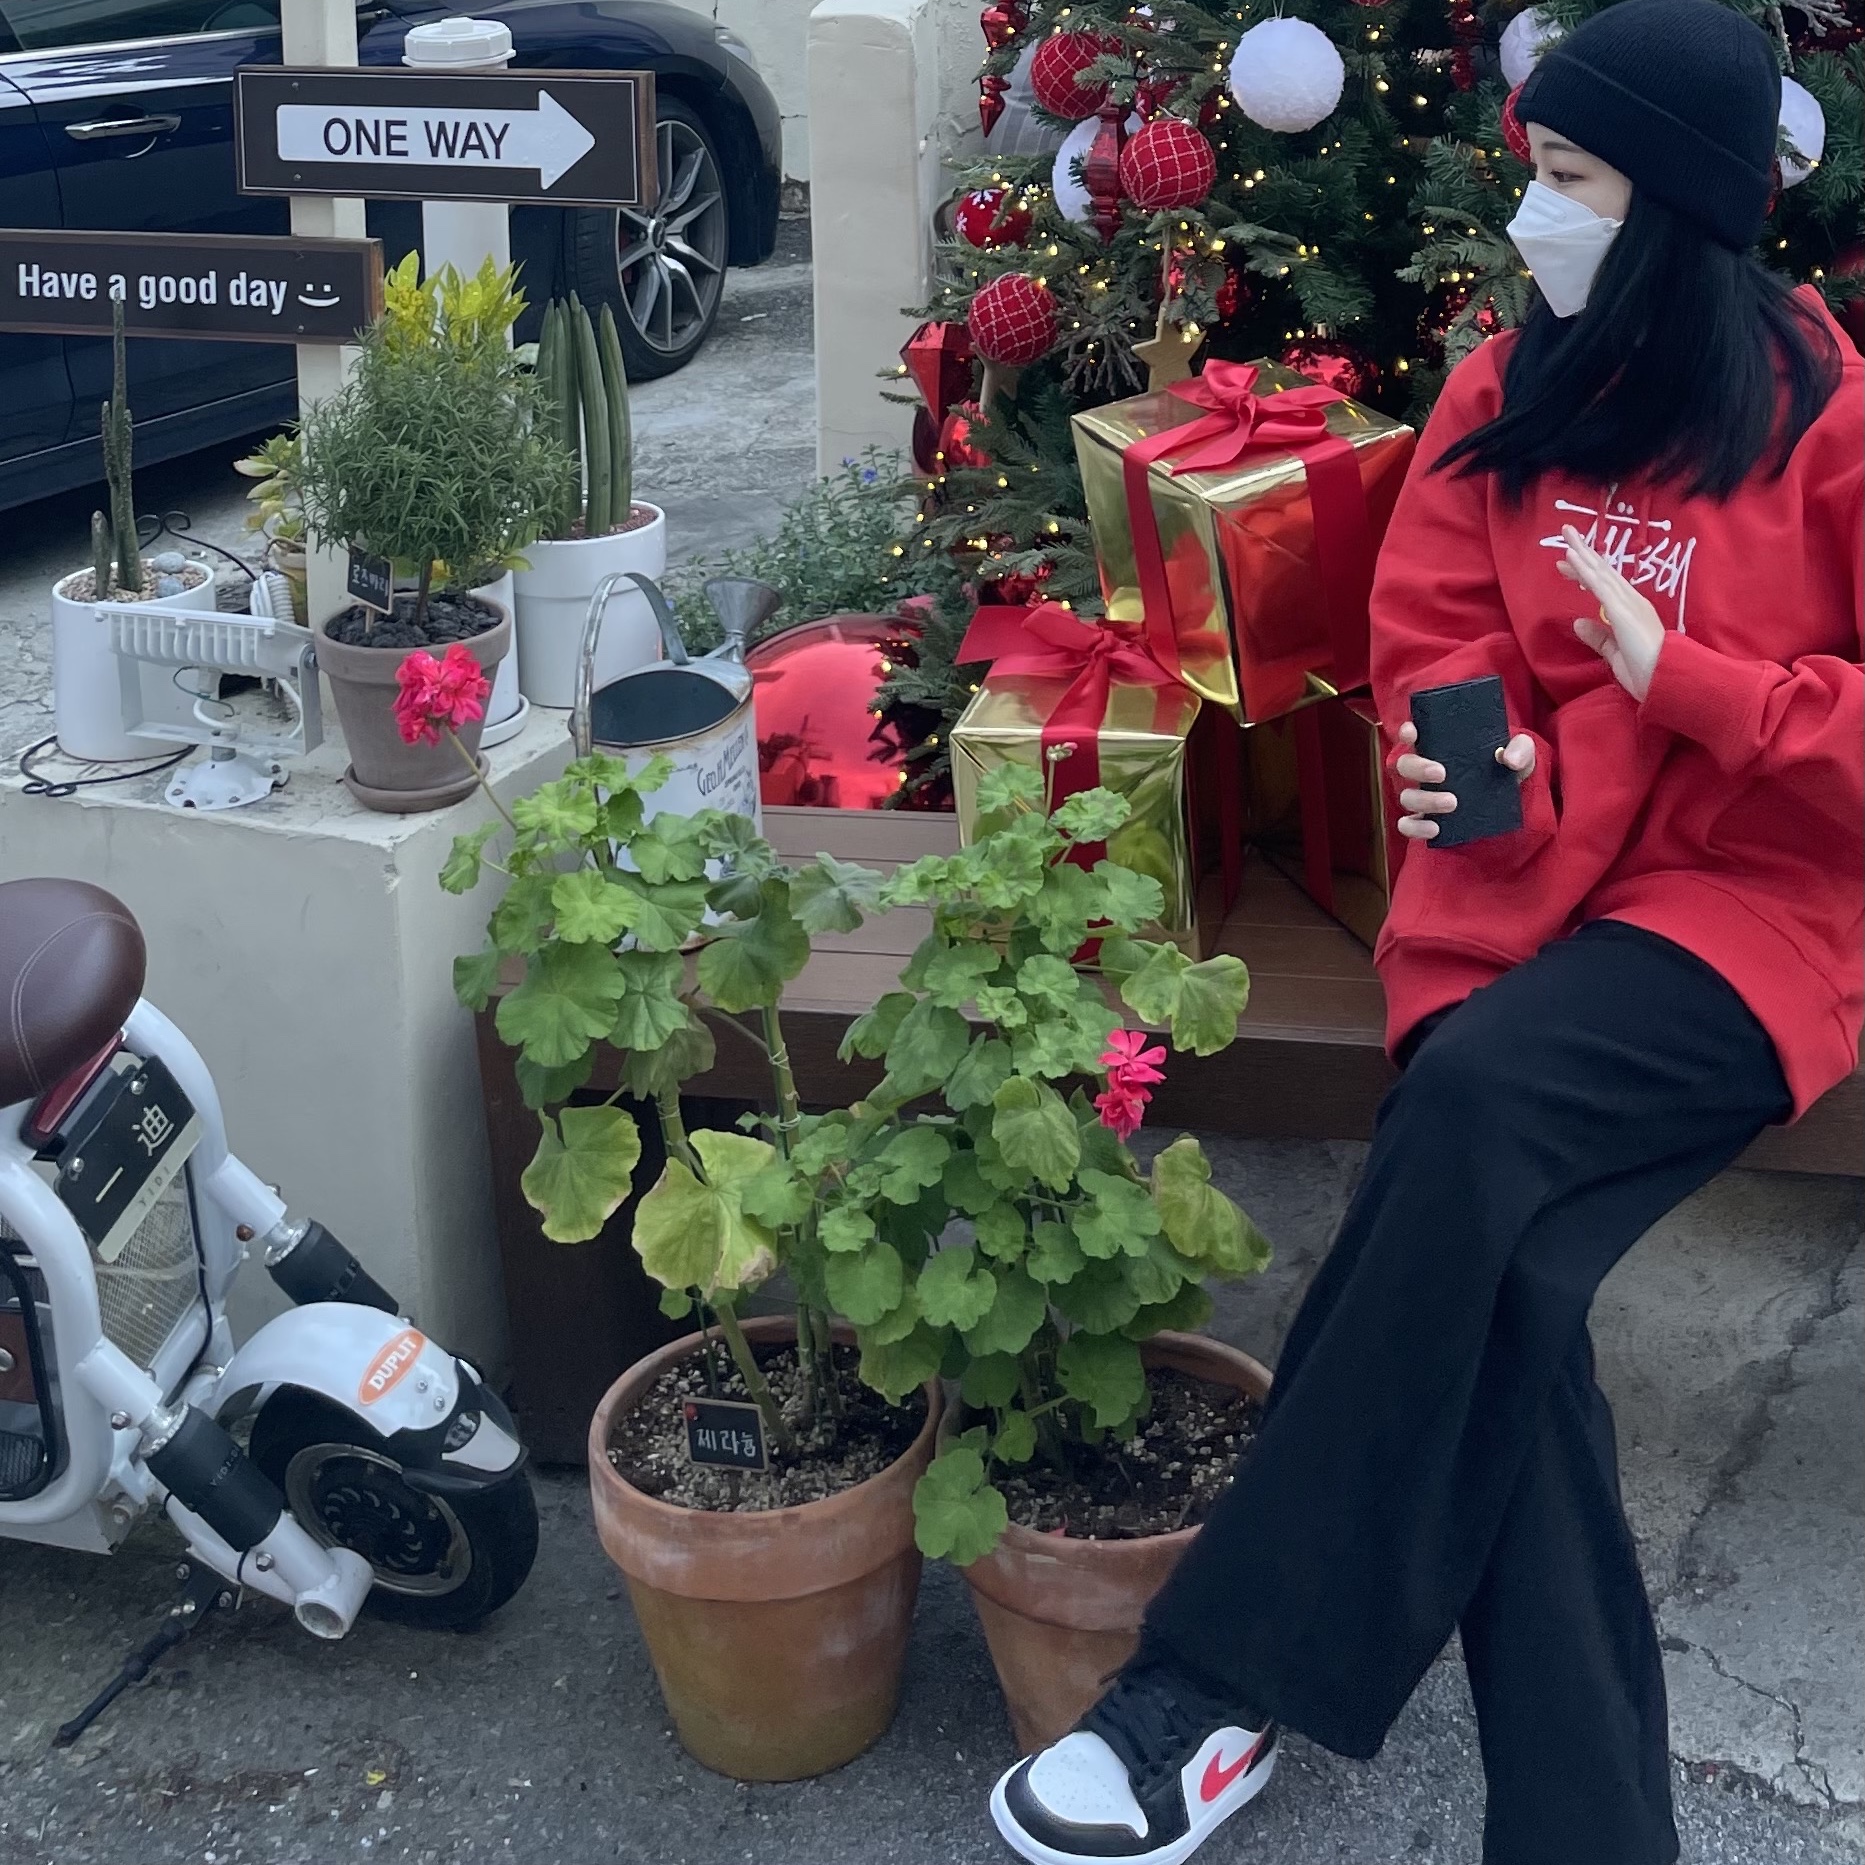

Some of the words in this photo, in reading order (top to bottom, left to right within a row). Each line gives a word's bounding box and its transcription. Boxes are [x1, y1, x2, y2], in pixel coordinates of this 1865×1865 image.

[323, 117, 409, 157] ONE
[423, 120, 511, 160] WAY
[18, 263, 97, 300] Have
[108, 273, 127, 301] a
[138, 270, 217, 310] good
[229, 271, 288, 316] day
[139, 1166, 170, 1206] YIDI
[368, 1337, 417, 1391] DUPLIT
